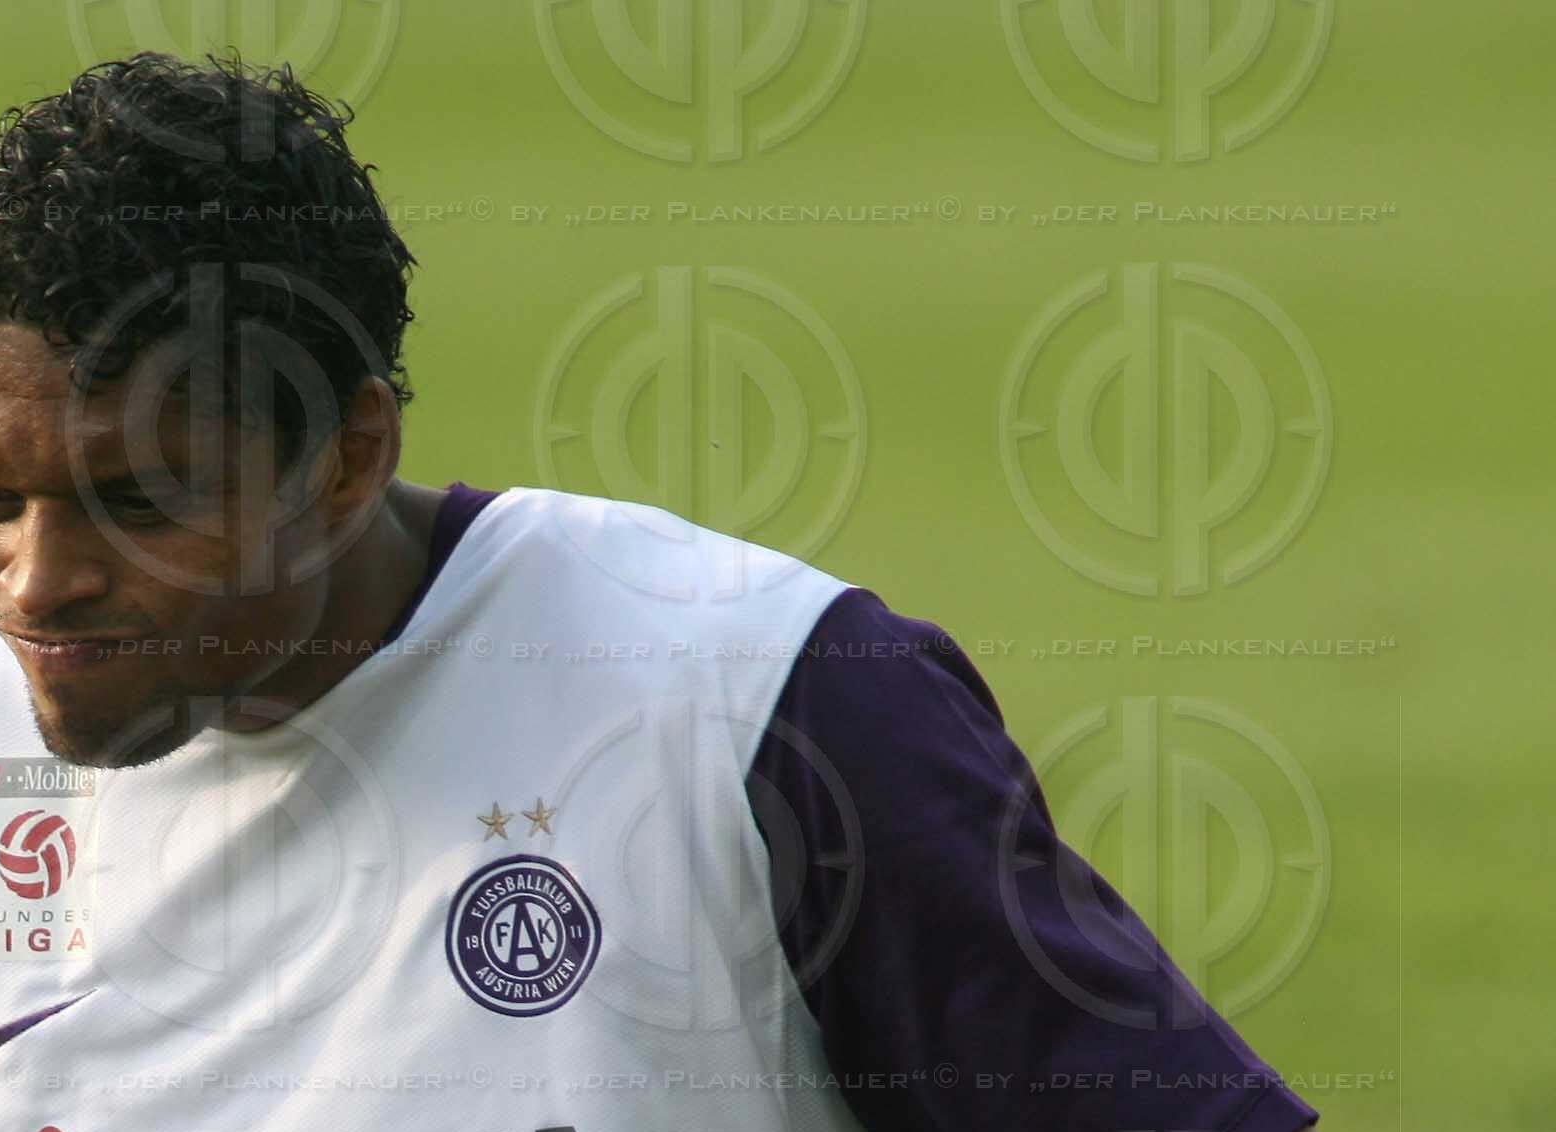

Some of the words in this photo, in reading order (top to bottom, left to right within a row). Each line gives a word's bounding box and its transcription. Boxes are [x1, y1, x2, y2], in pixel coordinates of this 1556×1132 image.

[471, 874, 572, 919] FUSSBALLKLUB
[465, 935, 479, 949] 19
[496, 903, 555, 972] FAK
[570, 925, 582, 939] 11
[475, 966, 542, 999] AUSTRIA
[543, 958, 576, 993] WIEN
